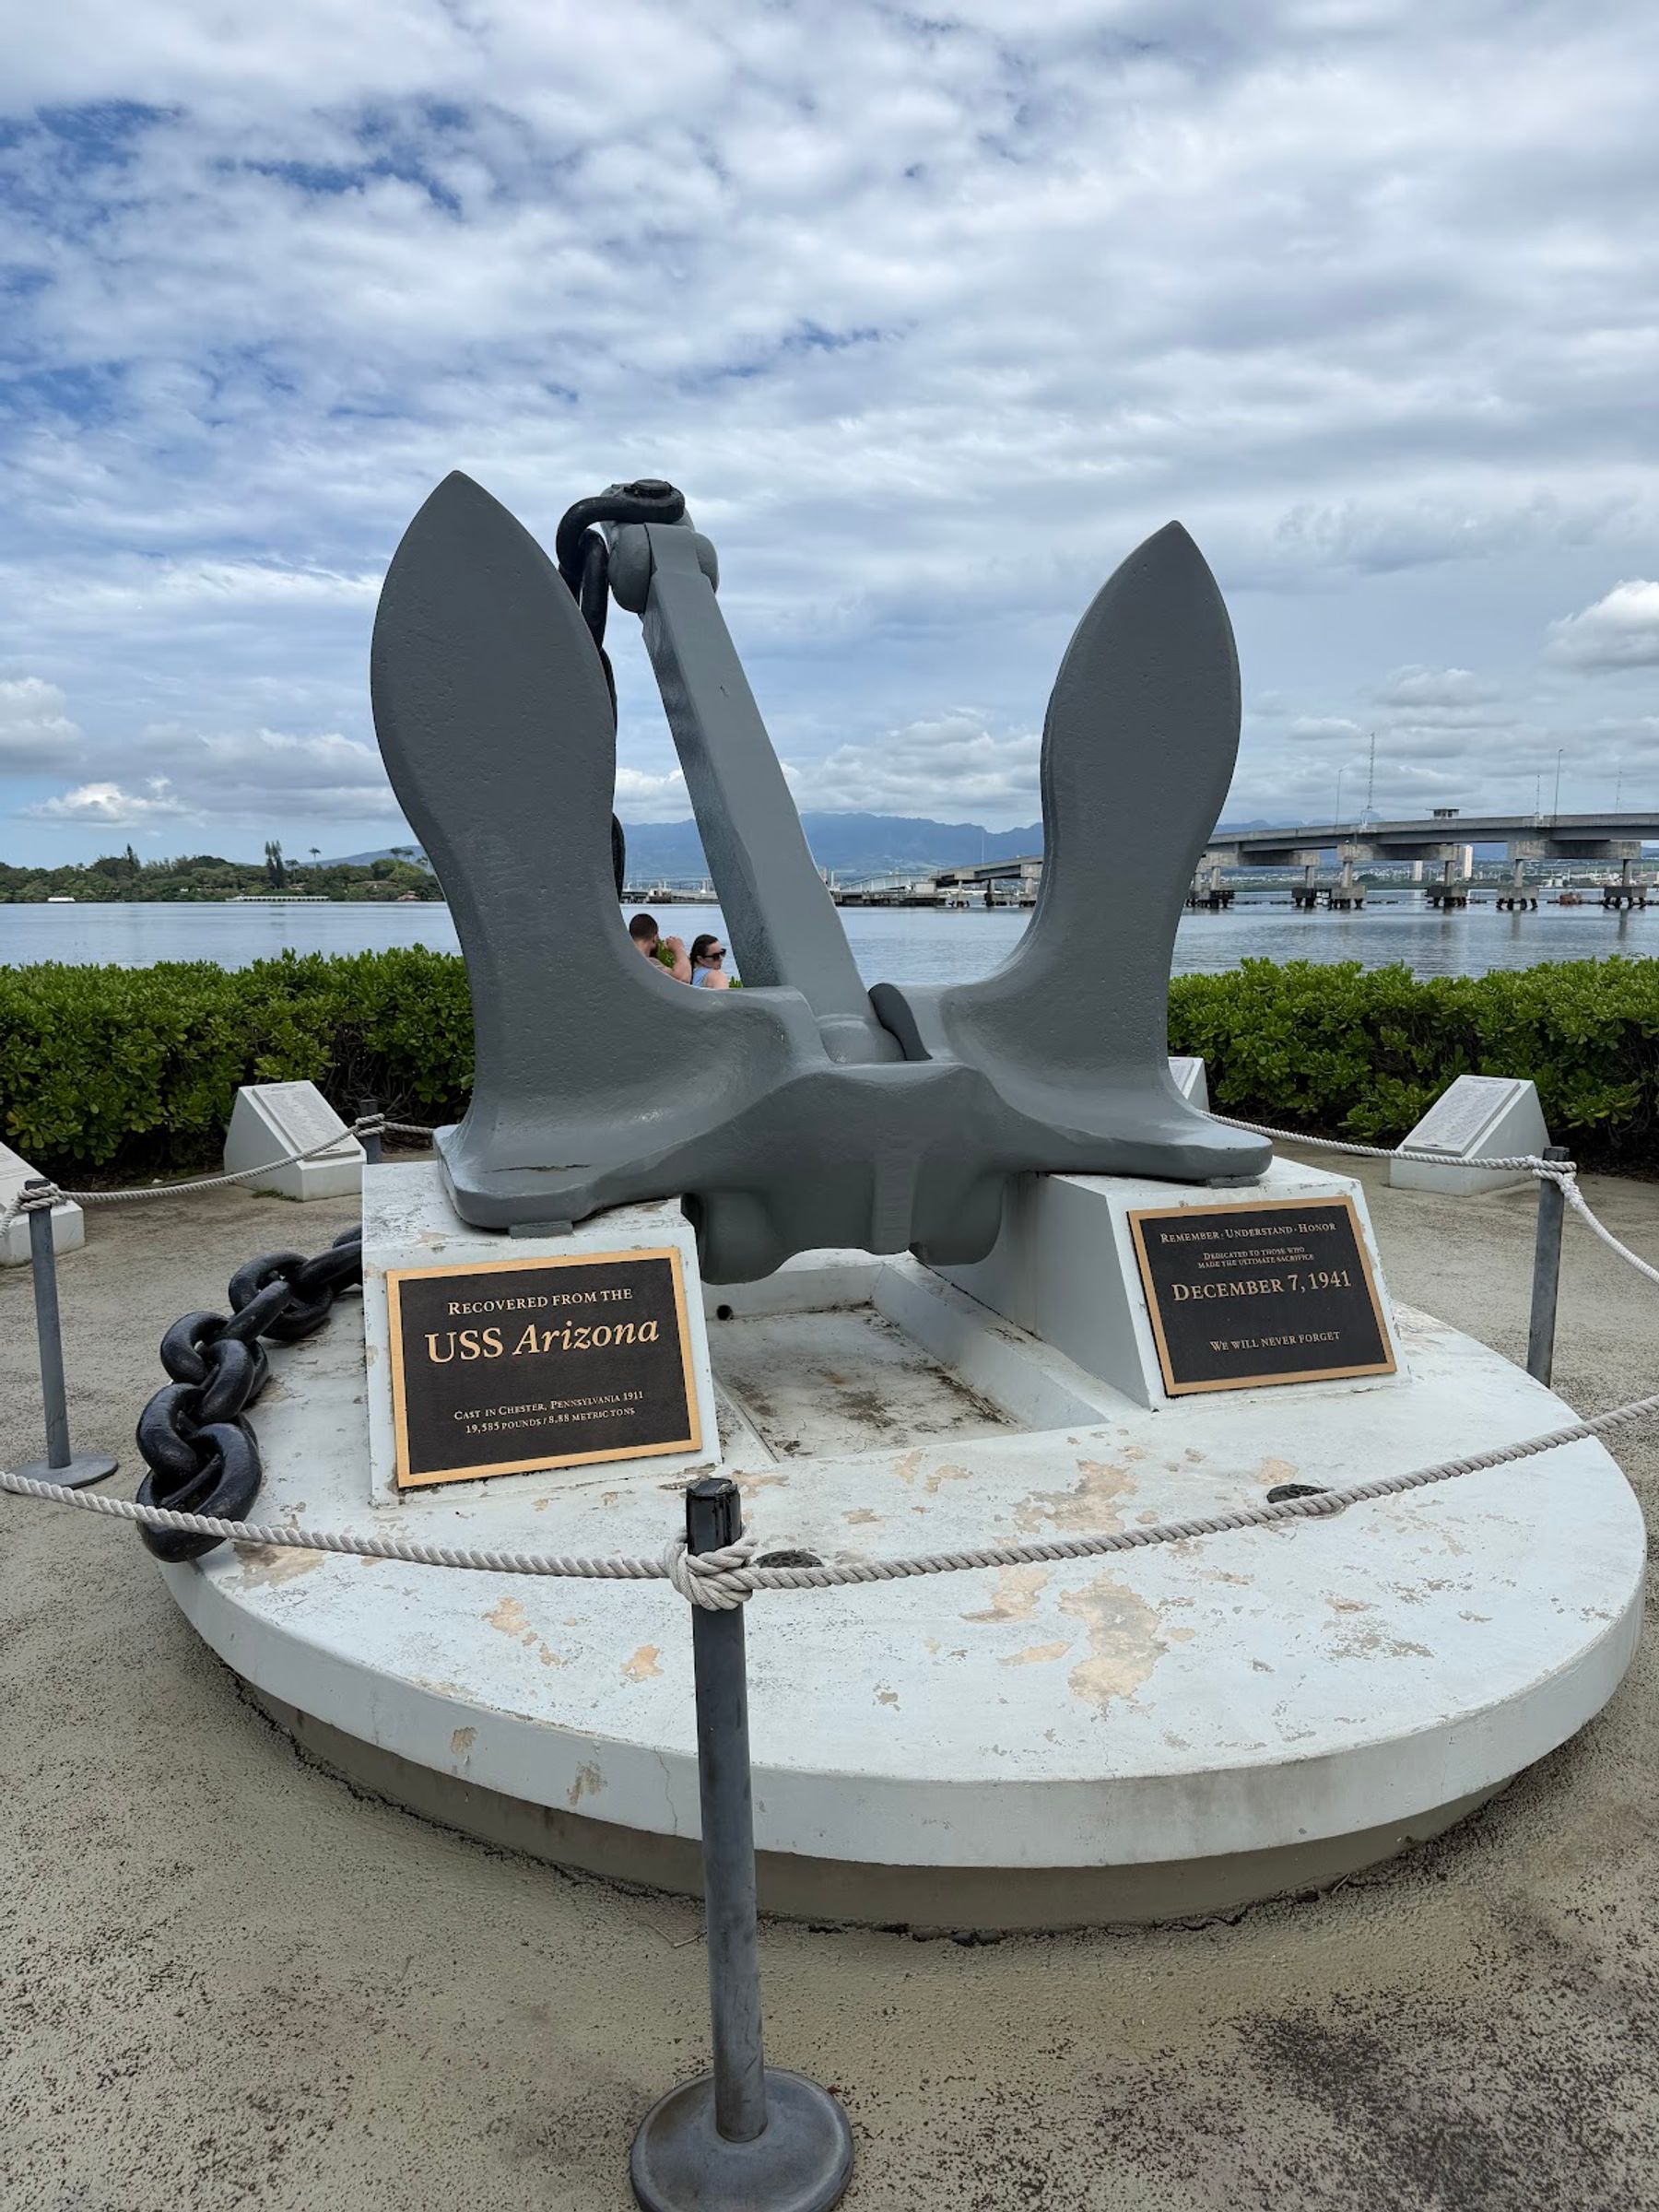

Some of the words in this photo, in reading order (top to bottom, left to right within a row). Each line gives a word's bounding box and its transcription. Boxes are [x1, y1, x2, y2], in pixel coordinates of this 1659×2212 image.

[1171, 1279, 1284, 1301] DECEMBER
[1288, 1274, 1306, 1294] 7,
[1308, 1269, 1352, 1290] 1941
[448, 1296, 547, 1315] RECOVERED
[552, 1291, 597, 1306] FROM
[600, 1288, 633, 1300] THE
[425, 1327, 503, 1363] USS
[512, 1319, 659, 1356] Arizona
[1210, 1341, 1230, 1352] WE
[1231, 1339, 1259, 1350] WILL
[1261, 1335, 1296, 1347] NEVER
[1299, 1331, 1340, 1344] FORGET
[453, 1409, 481, 1421] CAST
[485, 1407, 497, 1418] IN
[550, 1394, 620, 1410] PENNSYLVANIA
[623, 1391, 643, 1401] 1911
[465, 1421, 500, 1434] 19,585
[501, 1417, 542, 1430] POUNDS
[548, 1412, 570, 1424] 8.88
[571, 1409, 609, 1422] METRIC
[610, 1406, 636, 1418] TONS
